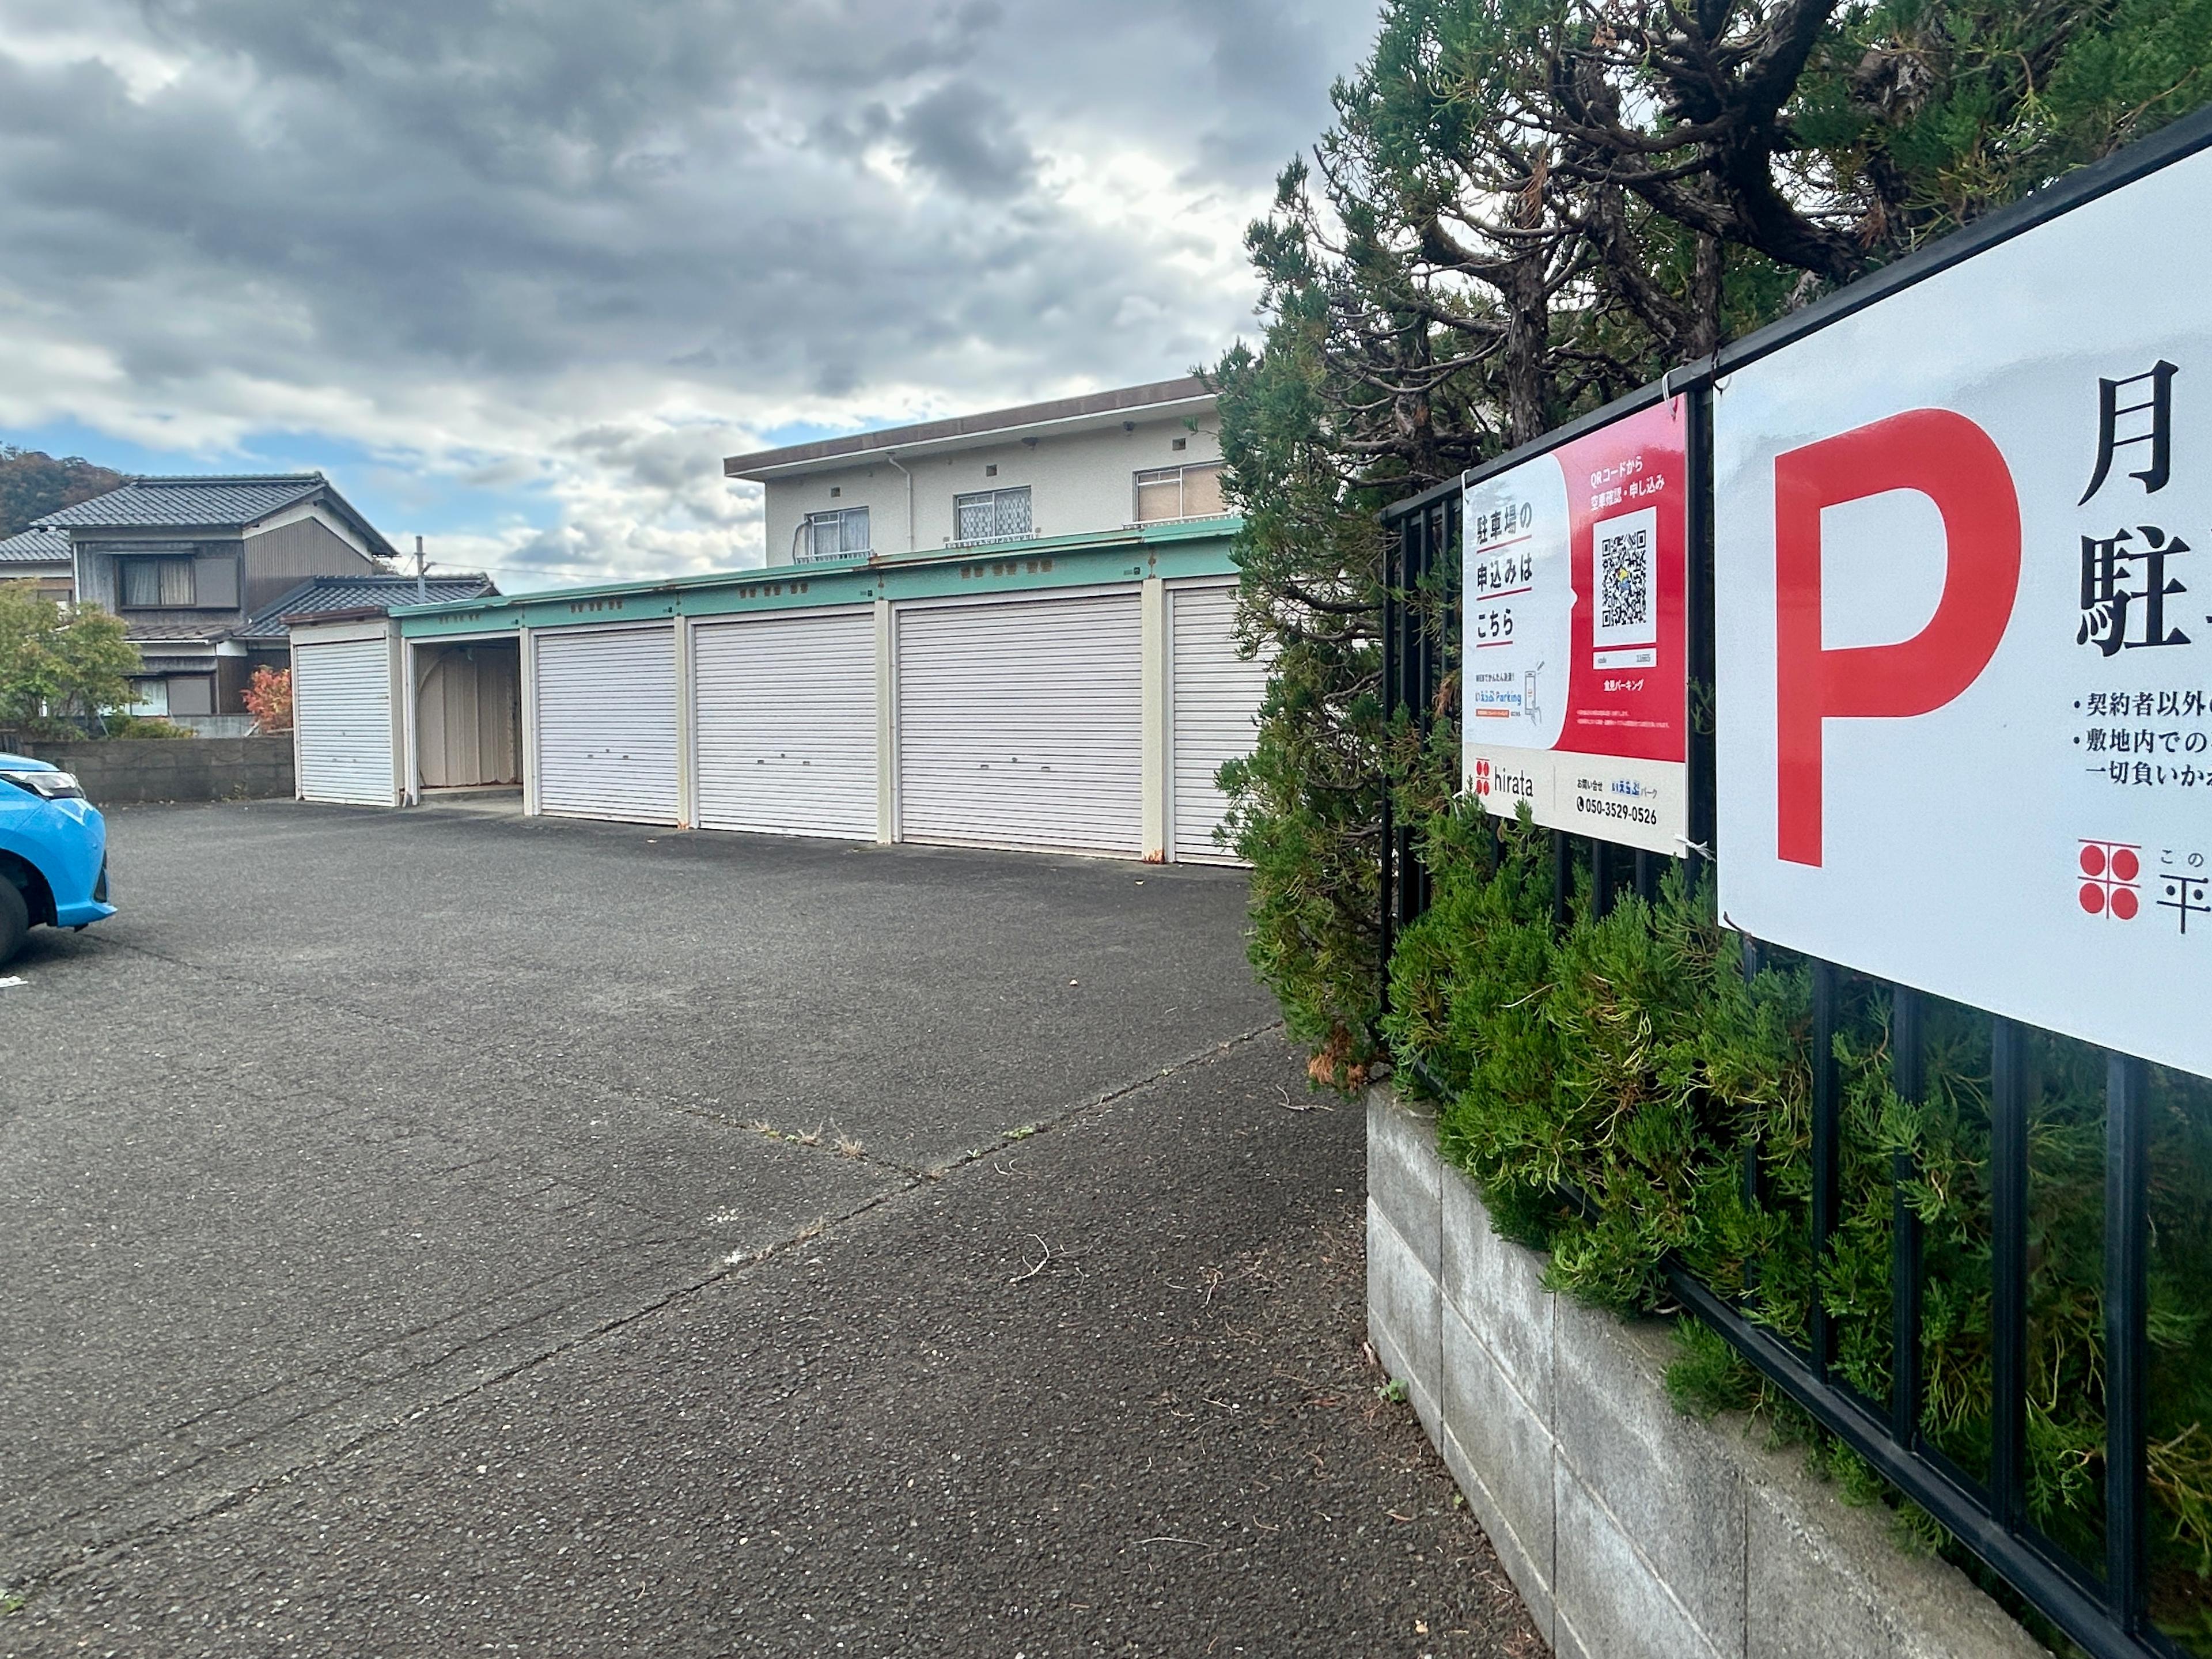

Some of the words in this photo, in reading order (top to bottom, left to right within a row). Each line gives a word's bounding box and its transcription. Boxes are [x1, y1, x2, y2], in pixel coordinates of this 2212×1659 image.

[2077, 359, 2179, 506] 月
[1590, 456, 1643, 488] QRコードから
[1476, 502, 1532, 544] 駐車場の
[1477, 552, 1532, 592] 申込みは
[2076, 525, 2212, 657] 駐
[1478, 608, 1513, 638] こちら
[1775, 407, 2022, 868] P
[2073, 691, 2212, 716] ・契約者以外
[2073, 728, 2212, 753] ・敷地内での
[1495, 766, 1533, 797] hirata
[2085, 761, 2212, 786] 一切負いか
[1586, 798, 1657, 825] 050-3529-0526
[2161, 849, 2204, 868] この
[2156, 874, 2211, 935] 平
